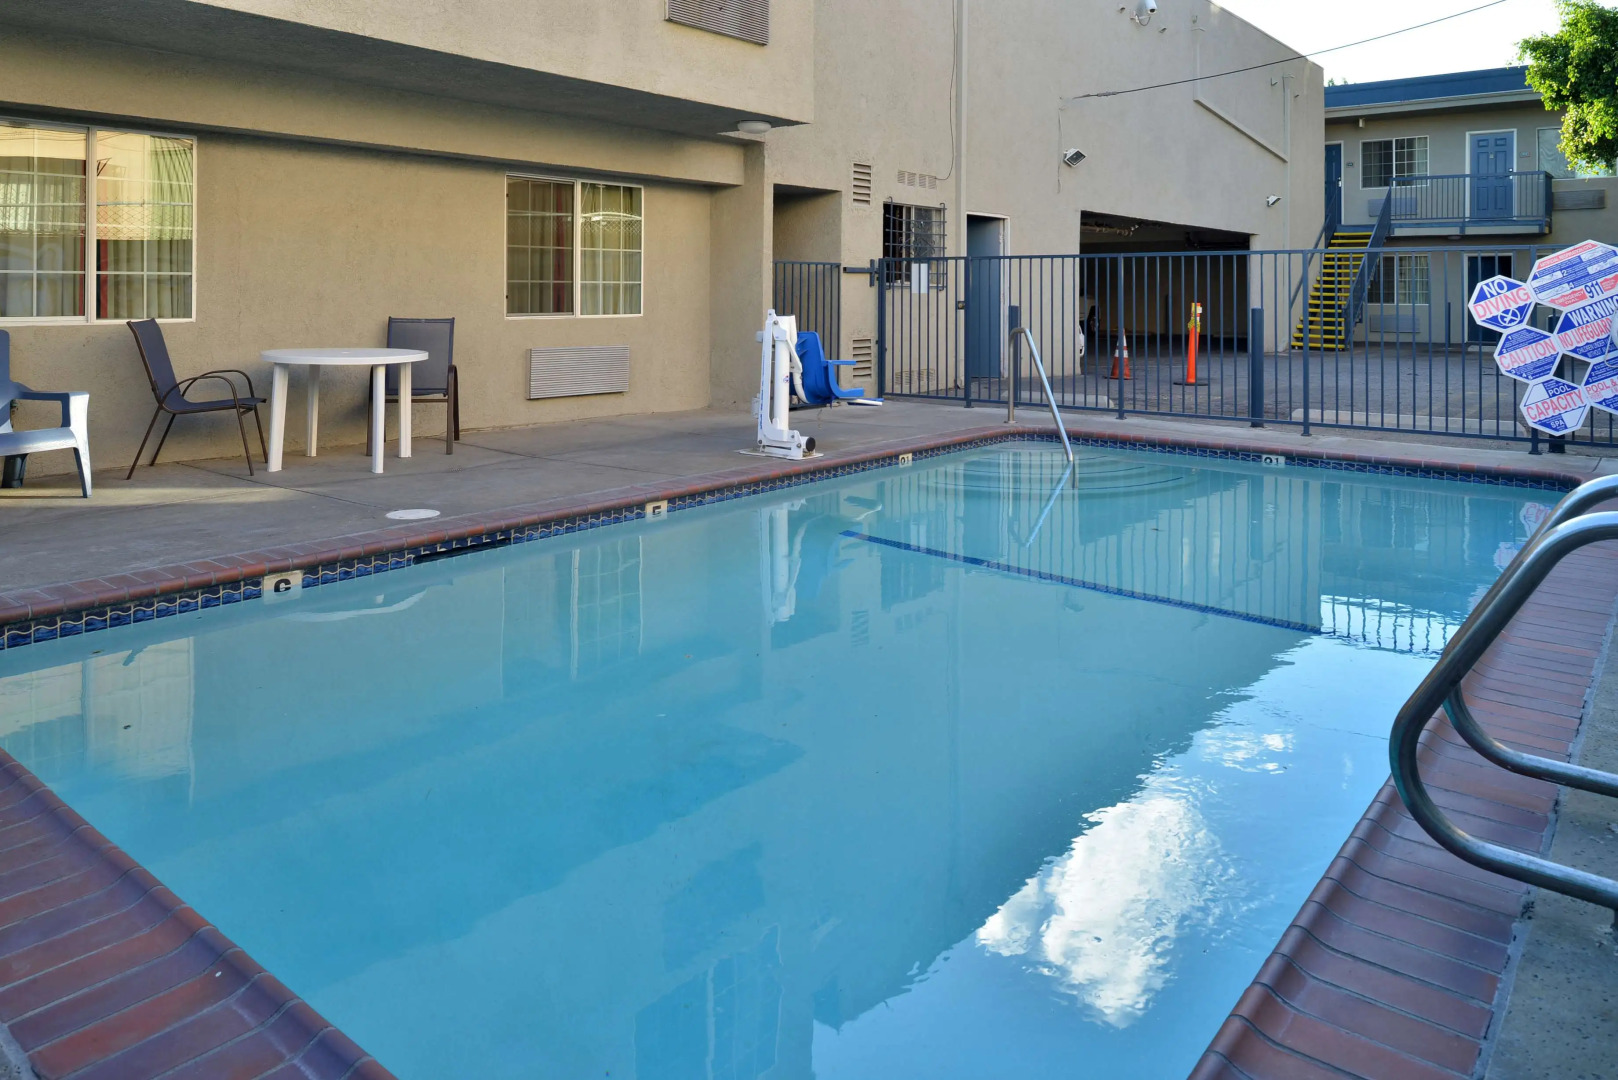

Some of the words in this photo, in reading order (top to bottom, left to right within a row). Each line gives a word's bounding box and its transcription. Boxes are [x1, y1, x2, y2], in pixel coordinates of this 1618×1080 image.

[1482, 279, 1508, 298] NO
[1584, 281, 1604, 299] 911
[1473, 287, 1531, 319] DIVING
[1558, 332, 1574, 349] NO
[1499, 338, 1557, 370] CAUTION
[1548, 385, 1571, 397] POOL
[1585, 381, 1610, 395] POOL
[1526, 388, 1585, 421] CAPACITY
[1550, 419, 1565, 428] SPA
